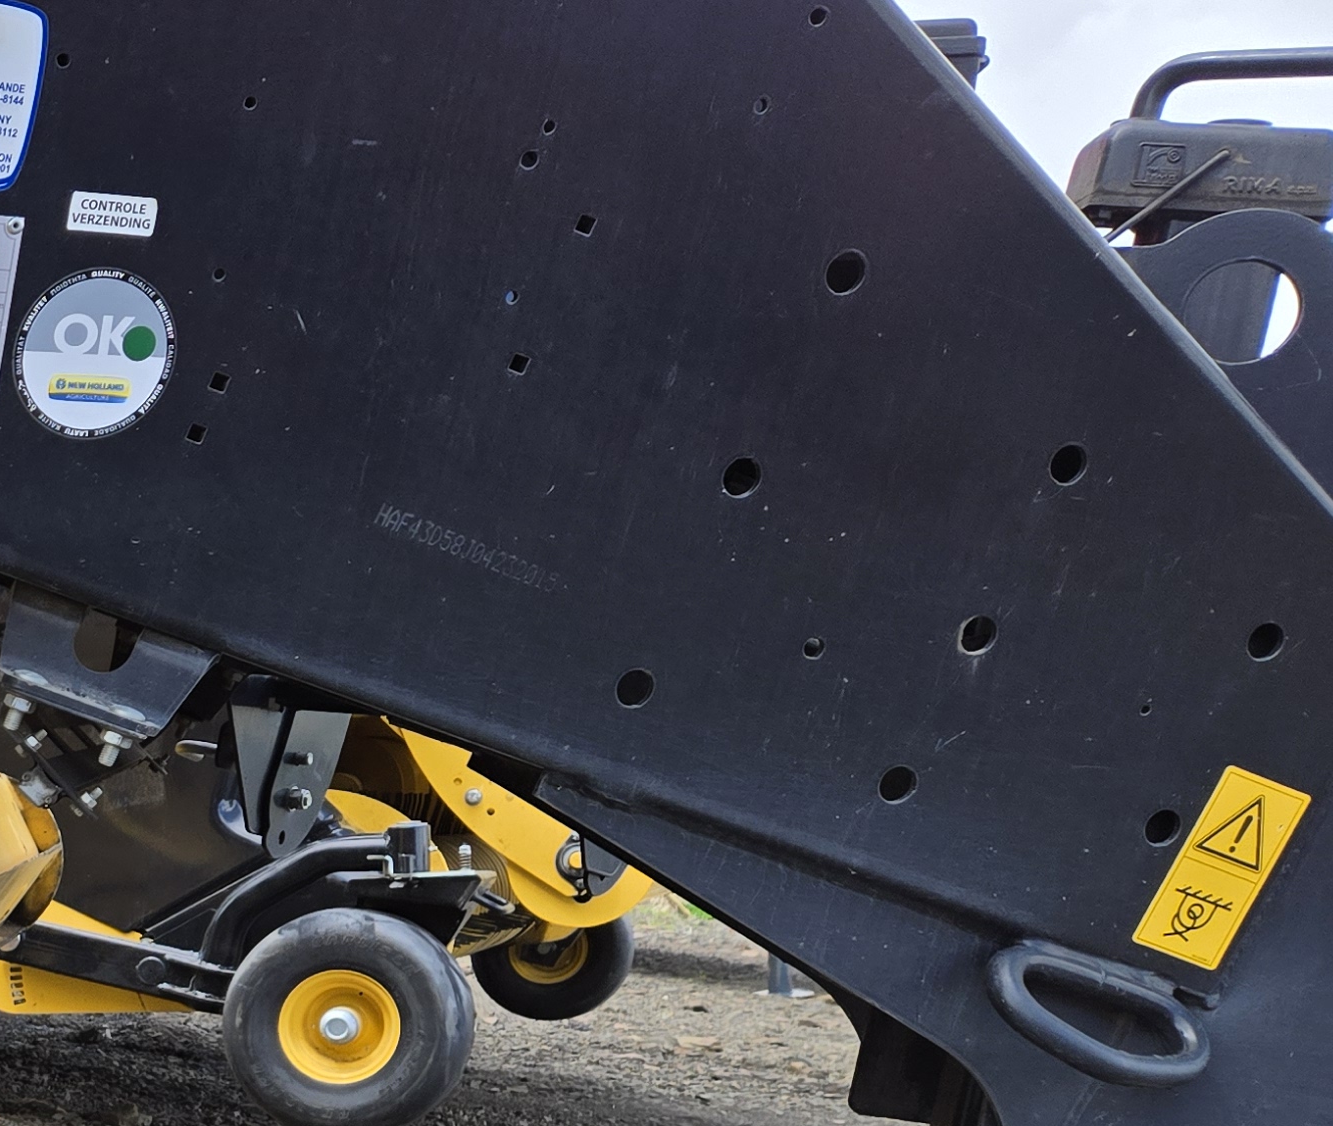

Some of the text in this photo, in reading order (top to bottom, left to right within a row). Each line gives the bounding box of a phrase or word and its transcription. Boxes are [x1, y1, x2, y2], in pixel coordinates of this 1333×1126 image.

[1222, 175, 1283, 196] RIMA
[80, 198, 147, 215] CONTROLE
[72, 212, 150, 230] VERZENDING
[91, 270, 125, 279] QUALITY
[53, 313, 136, 357] OK
[162, 344, 175, 380] CALIDAD
[87, 382, 124, 390] HOLLAND
